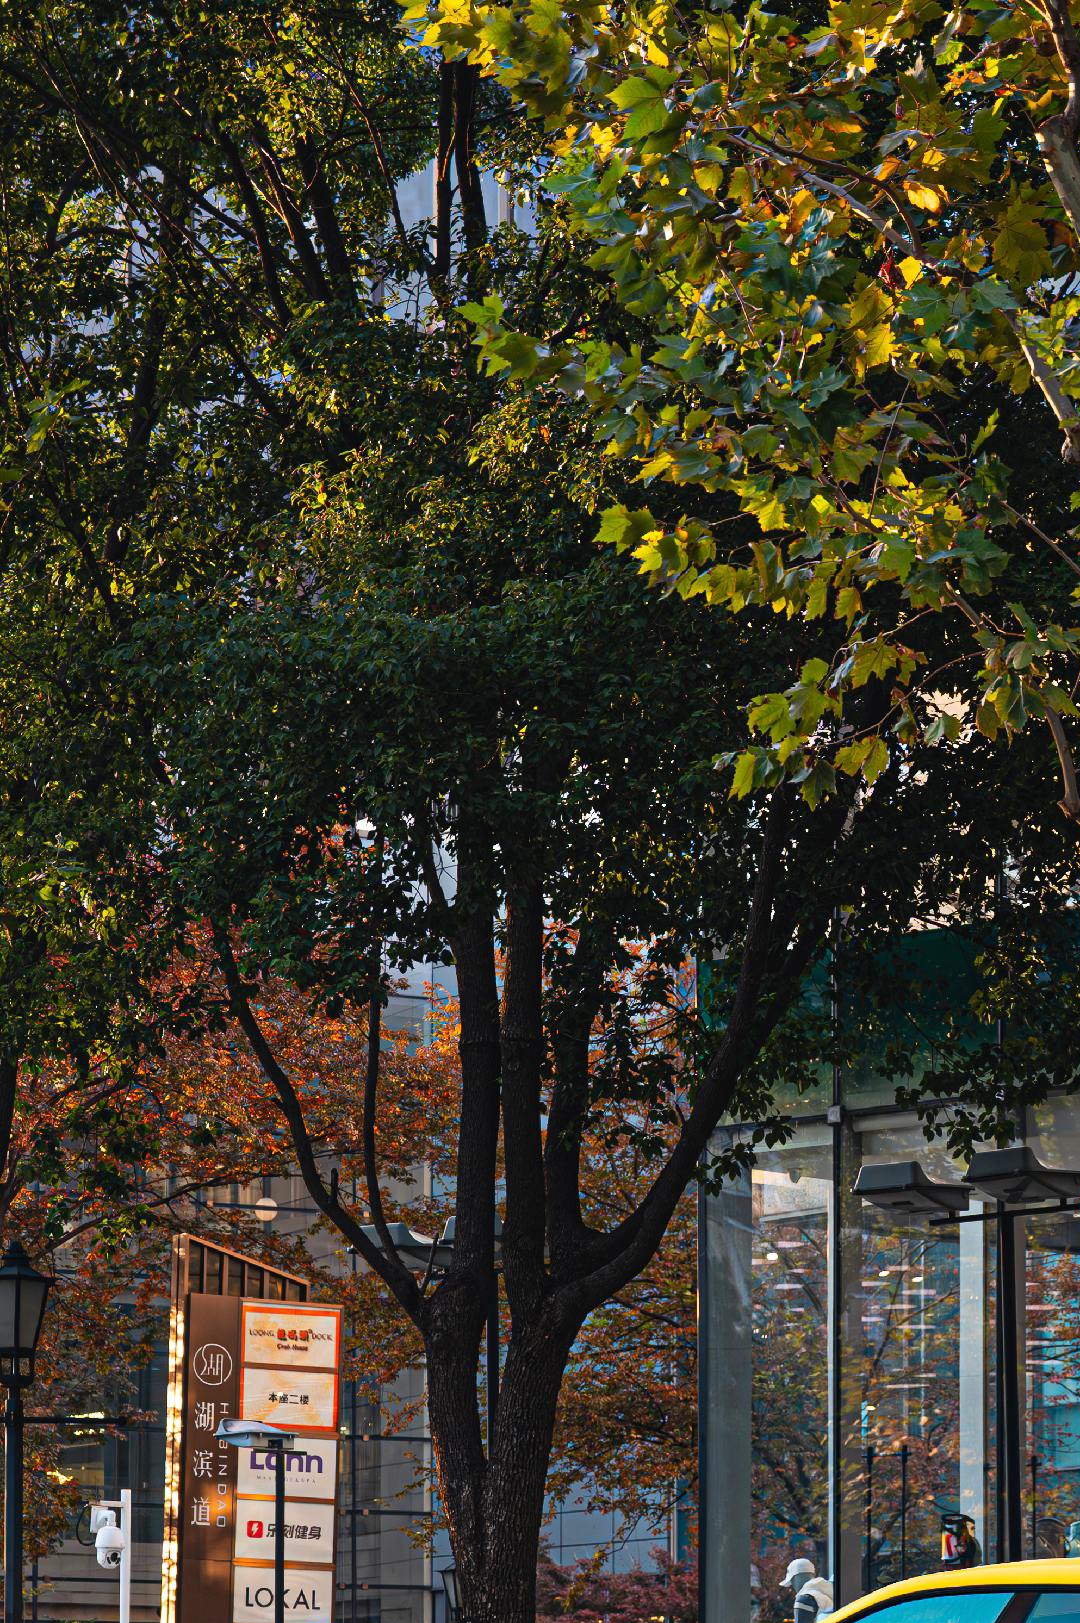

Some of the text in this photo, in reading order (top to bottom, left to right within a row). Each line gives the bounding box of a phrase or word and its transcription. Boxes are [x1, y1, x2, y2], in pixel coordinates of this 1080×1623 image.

[190, 1401, 215, 1527] 湖滨道
[216, 1402, 230, 1528] HBINDAO
[245, 1586, 321, 1610] LOKAL
